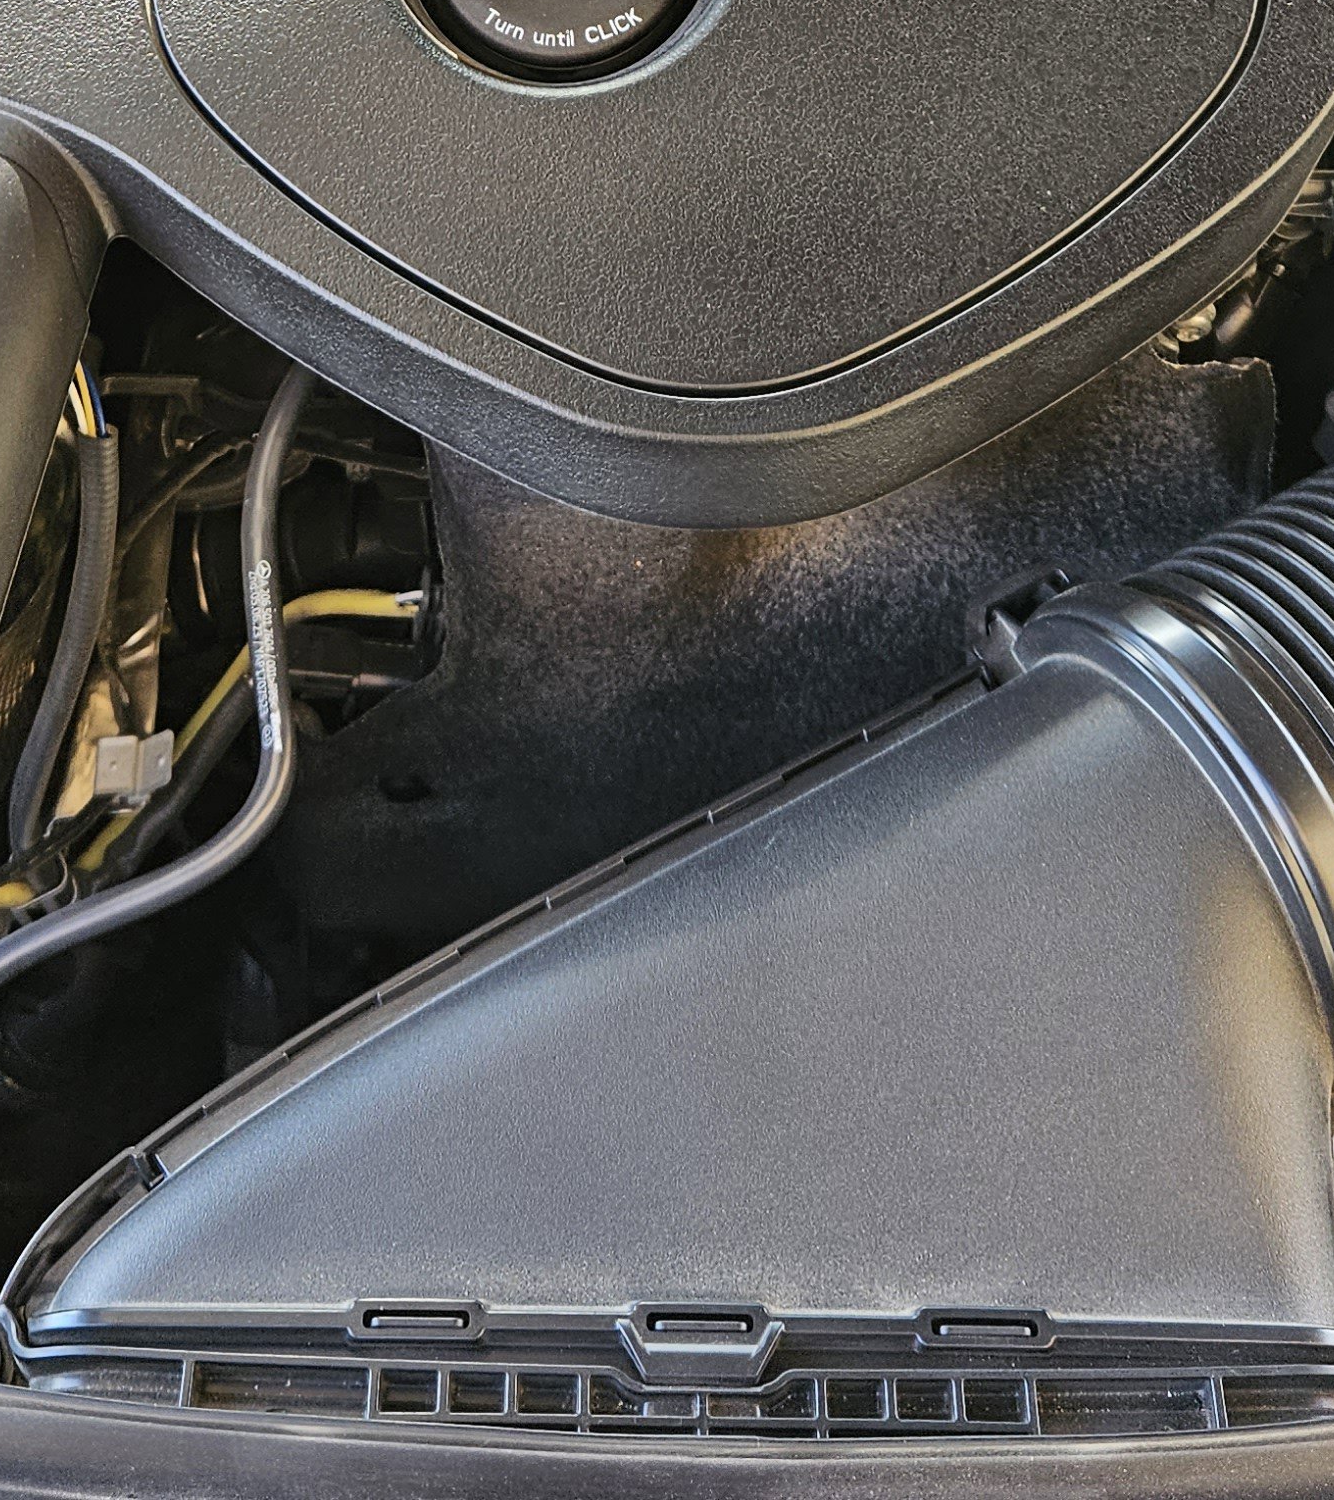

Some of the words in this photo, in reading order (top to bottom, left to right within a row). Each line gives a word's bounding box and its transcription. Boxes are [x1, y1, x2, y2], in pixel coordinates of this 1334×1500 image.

[484, 8, 524, 40] Turn
[533, 30, 575, 47] until
[585, 8, 643, 43] CLICK
